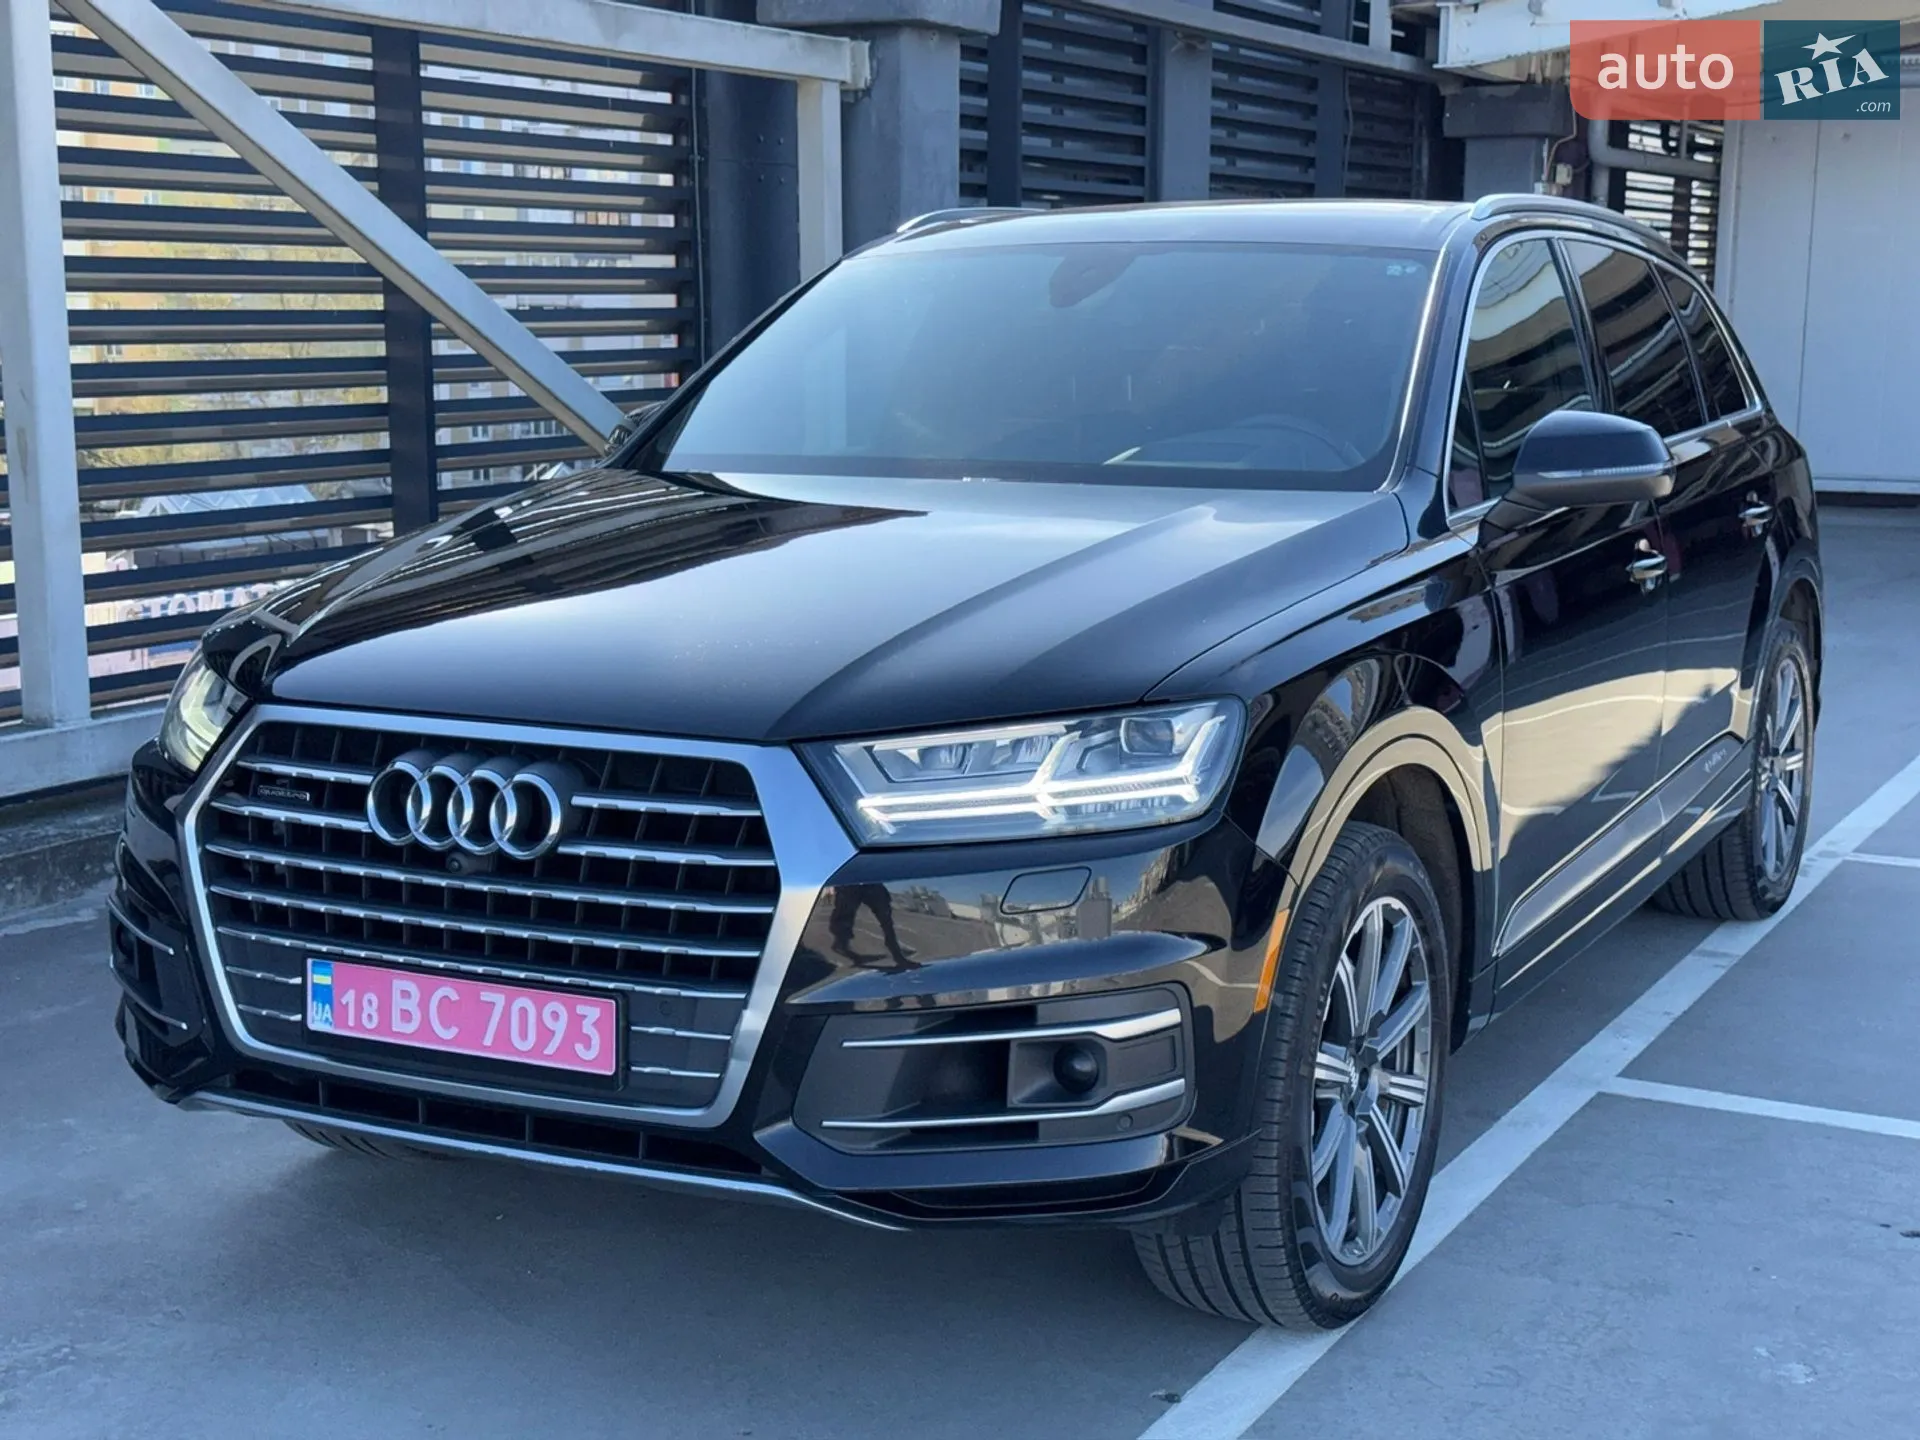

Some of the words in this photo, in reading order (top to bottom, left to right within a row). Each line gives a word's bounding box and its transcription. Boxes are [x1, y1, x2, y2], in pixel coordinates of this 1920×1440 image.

[312, 1001, 333, 1026] UA
[340, 989, 379, 1030] 18
[391, 979, 460, 1040] BC
[480, 991, 601, 1061] 7093
